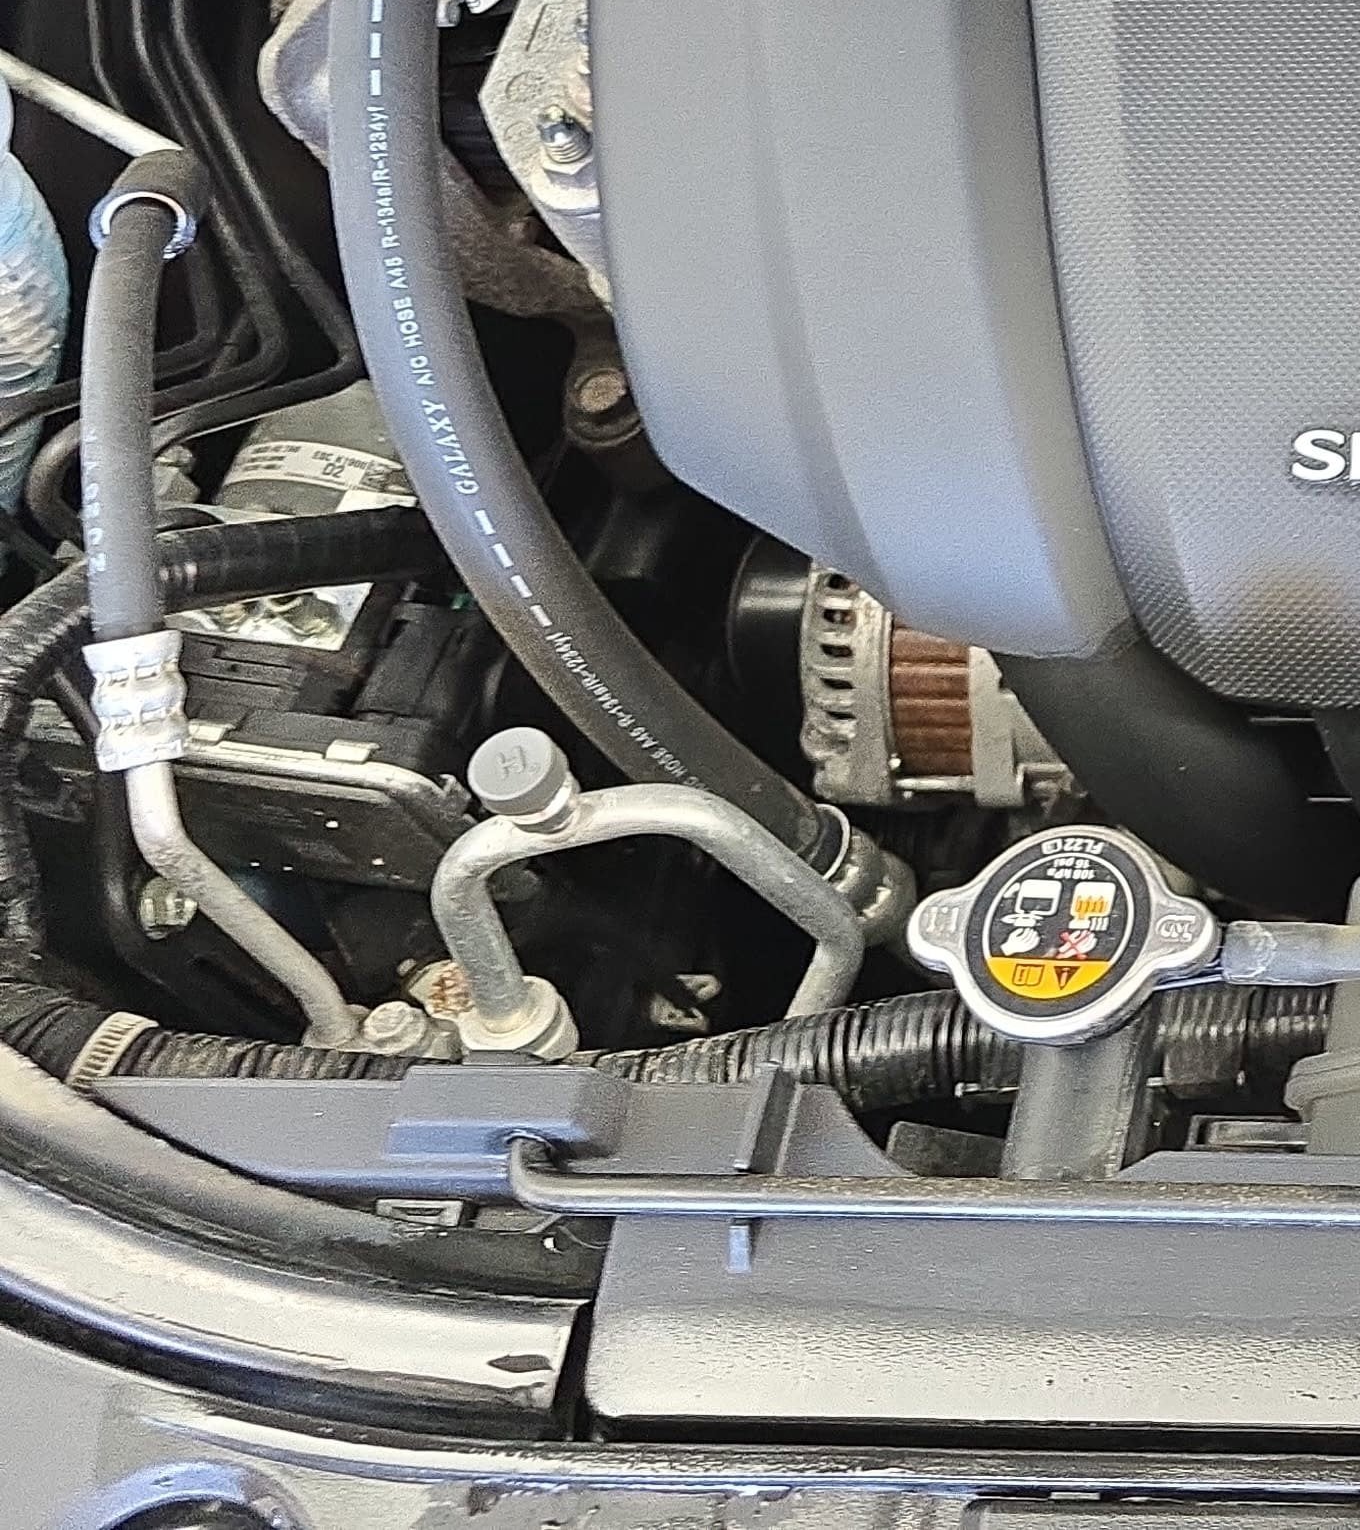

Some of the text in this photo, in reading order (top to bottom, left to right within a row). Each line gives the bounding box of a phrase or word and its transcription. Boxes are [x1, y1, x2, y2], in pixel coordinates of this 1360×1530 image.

[393, 296, 423, 349] HOSE
[421, 397, 480, 495] GALAXY
[1063, 837, 1105, 855] FL22
